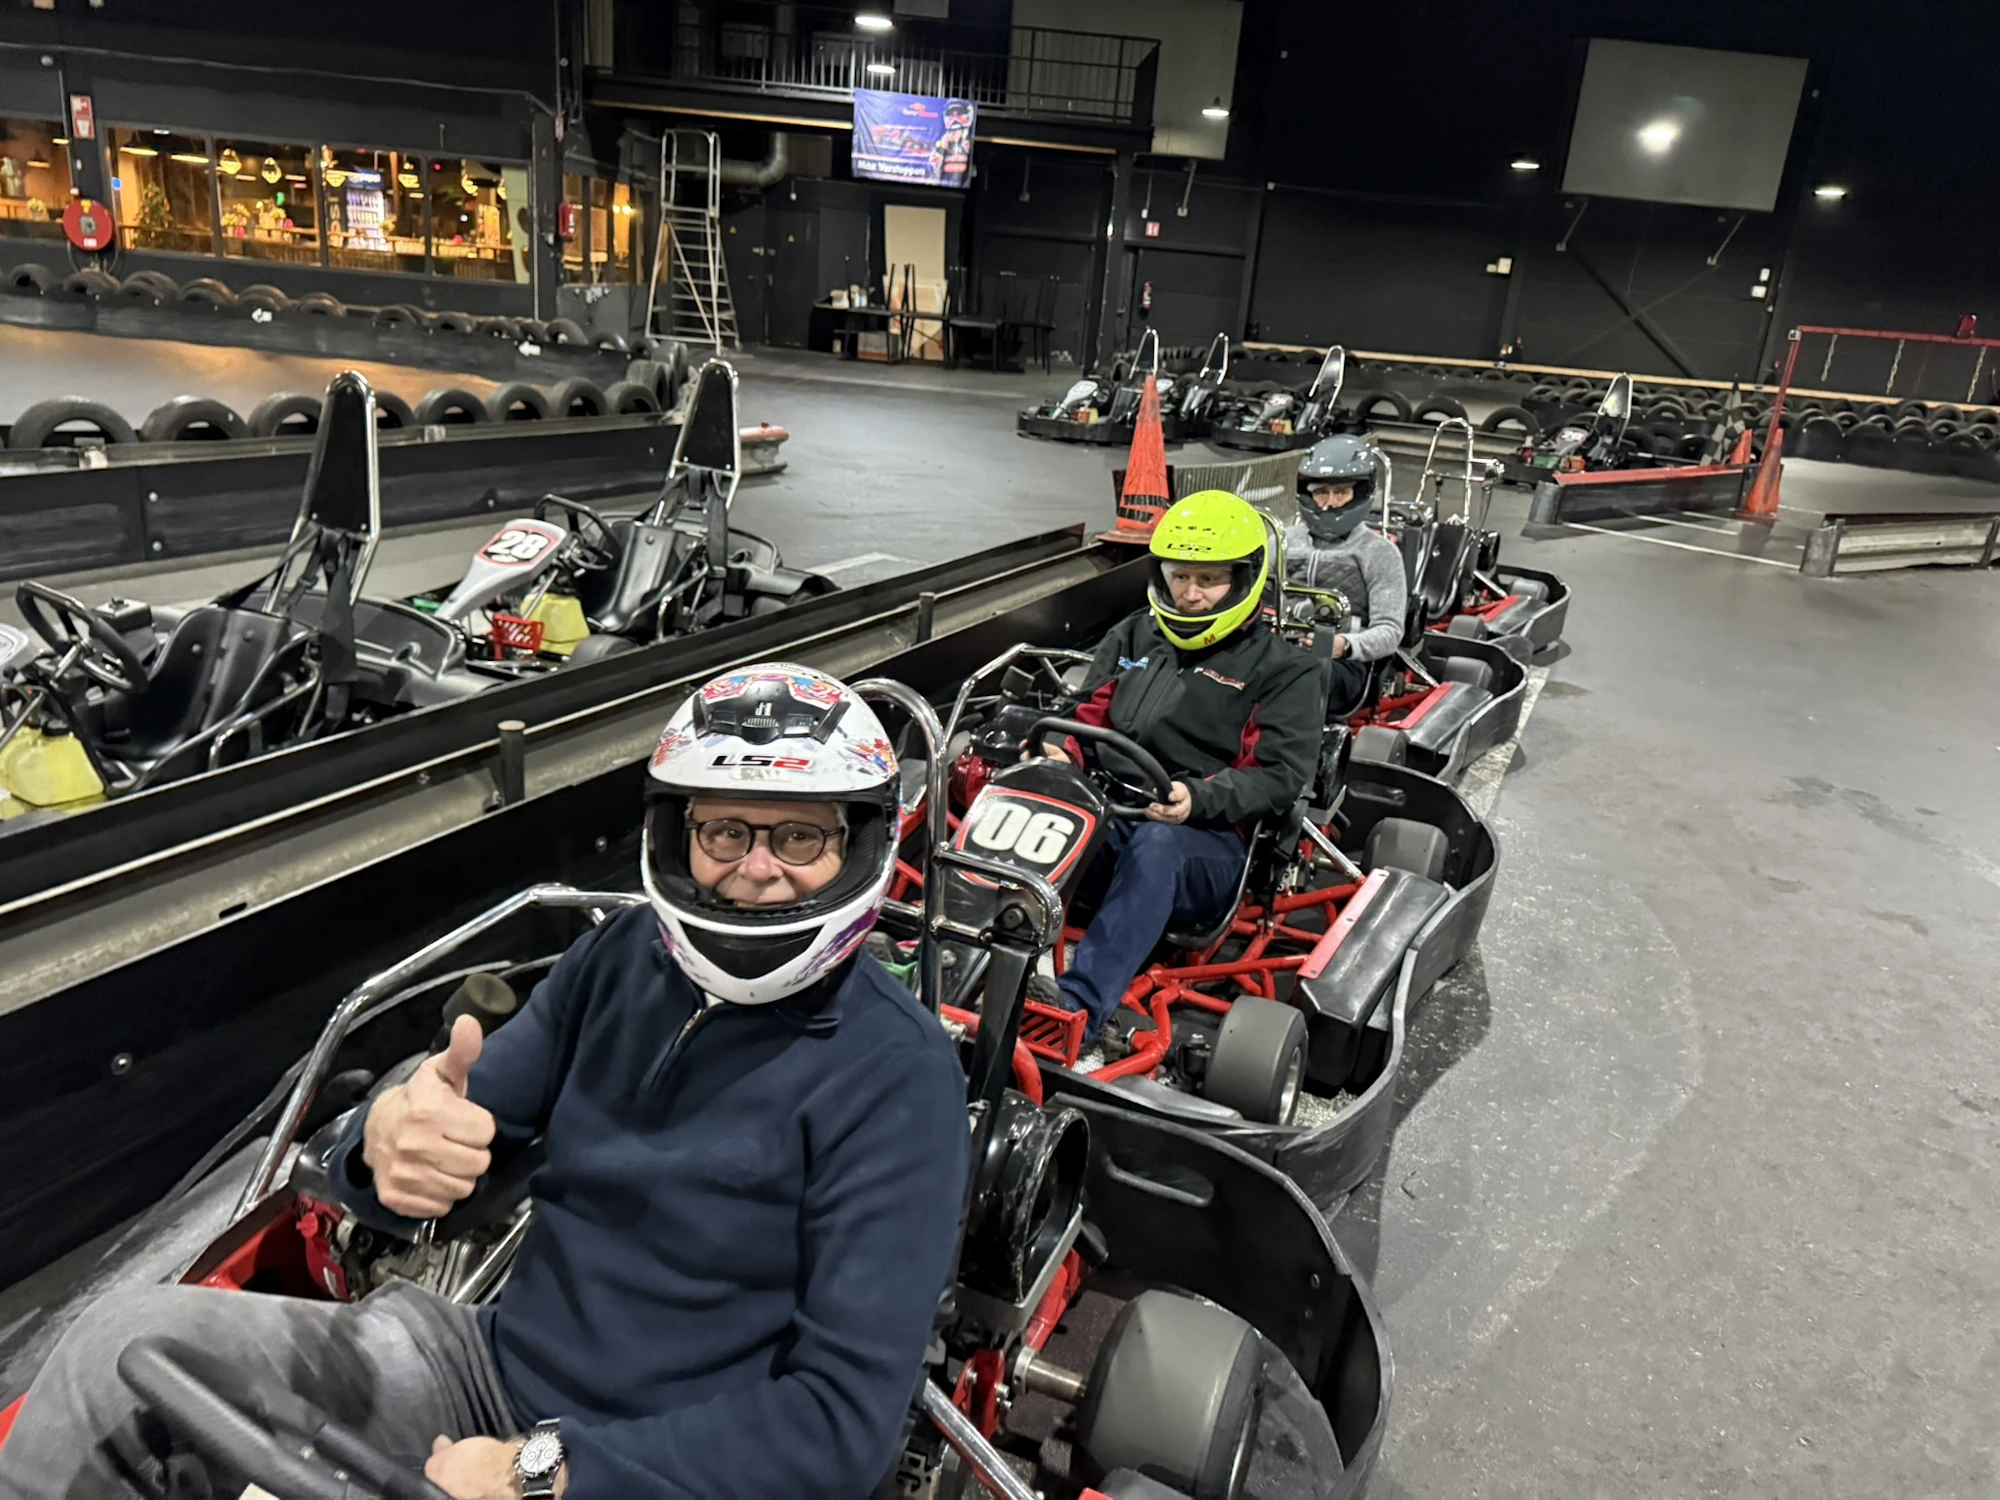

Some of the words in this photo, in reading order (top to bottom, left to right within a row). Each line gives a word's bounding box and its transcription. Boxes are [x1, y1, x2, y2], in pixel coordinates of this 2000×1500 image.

[487, 530, 549, 560] 28
[1166, 543, 1212, 554] LS2
[1203, 634, 1216, 645] M
[710, 755, 811, 771] LS2
[971, 802, 1076, 865] 06
